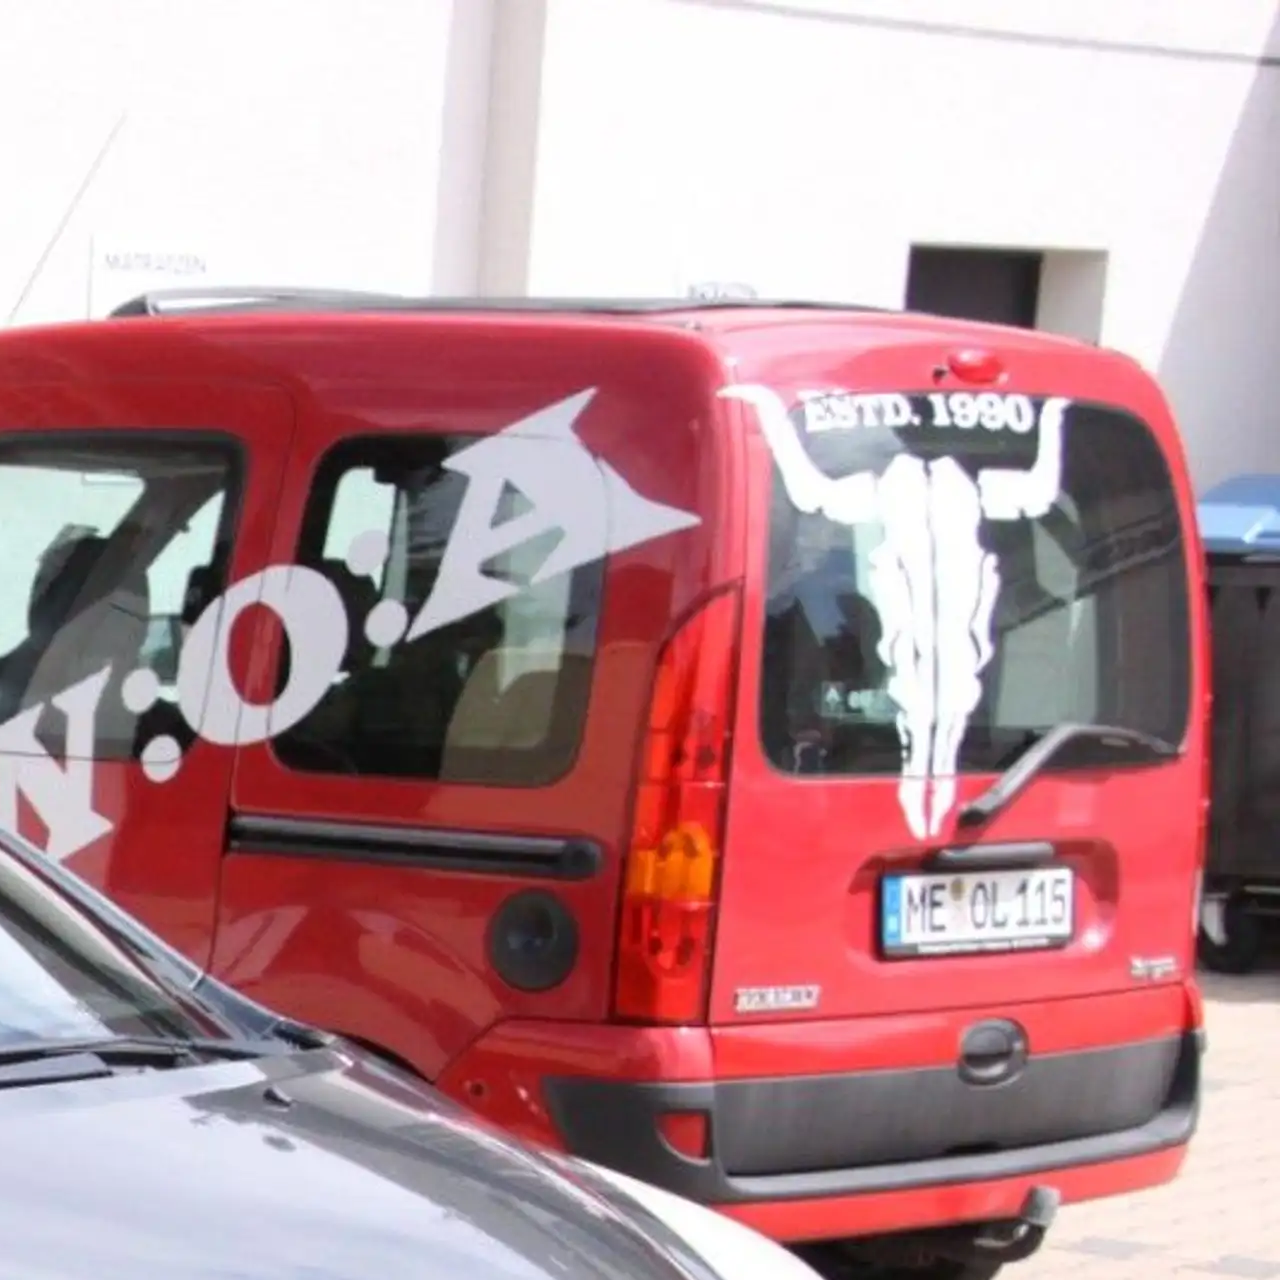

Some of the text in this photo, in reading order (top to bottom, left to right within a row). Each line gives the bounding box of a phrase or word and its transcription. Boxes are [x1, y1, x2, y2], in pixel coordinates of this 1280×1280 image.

[798, 389, 1035, 434] ESTD. 1990
[905, 877, 1067, 934] ME OL 115
